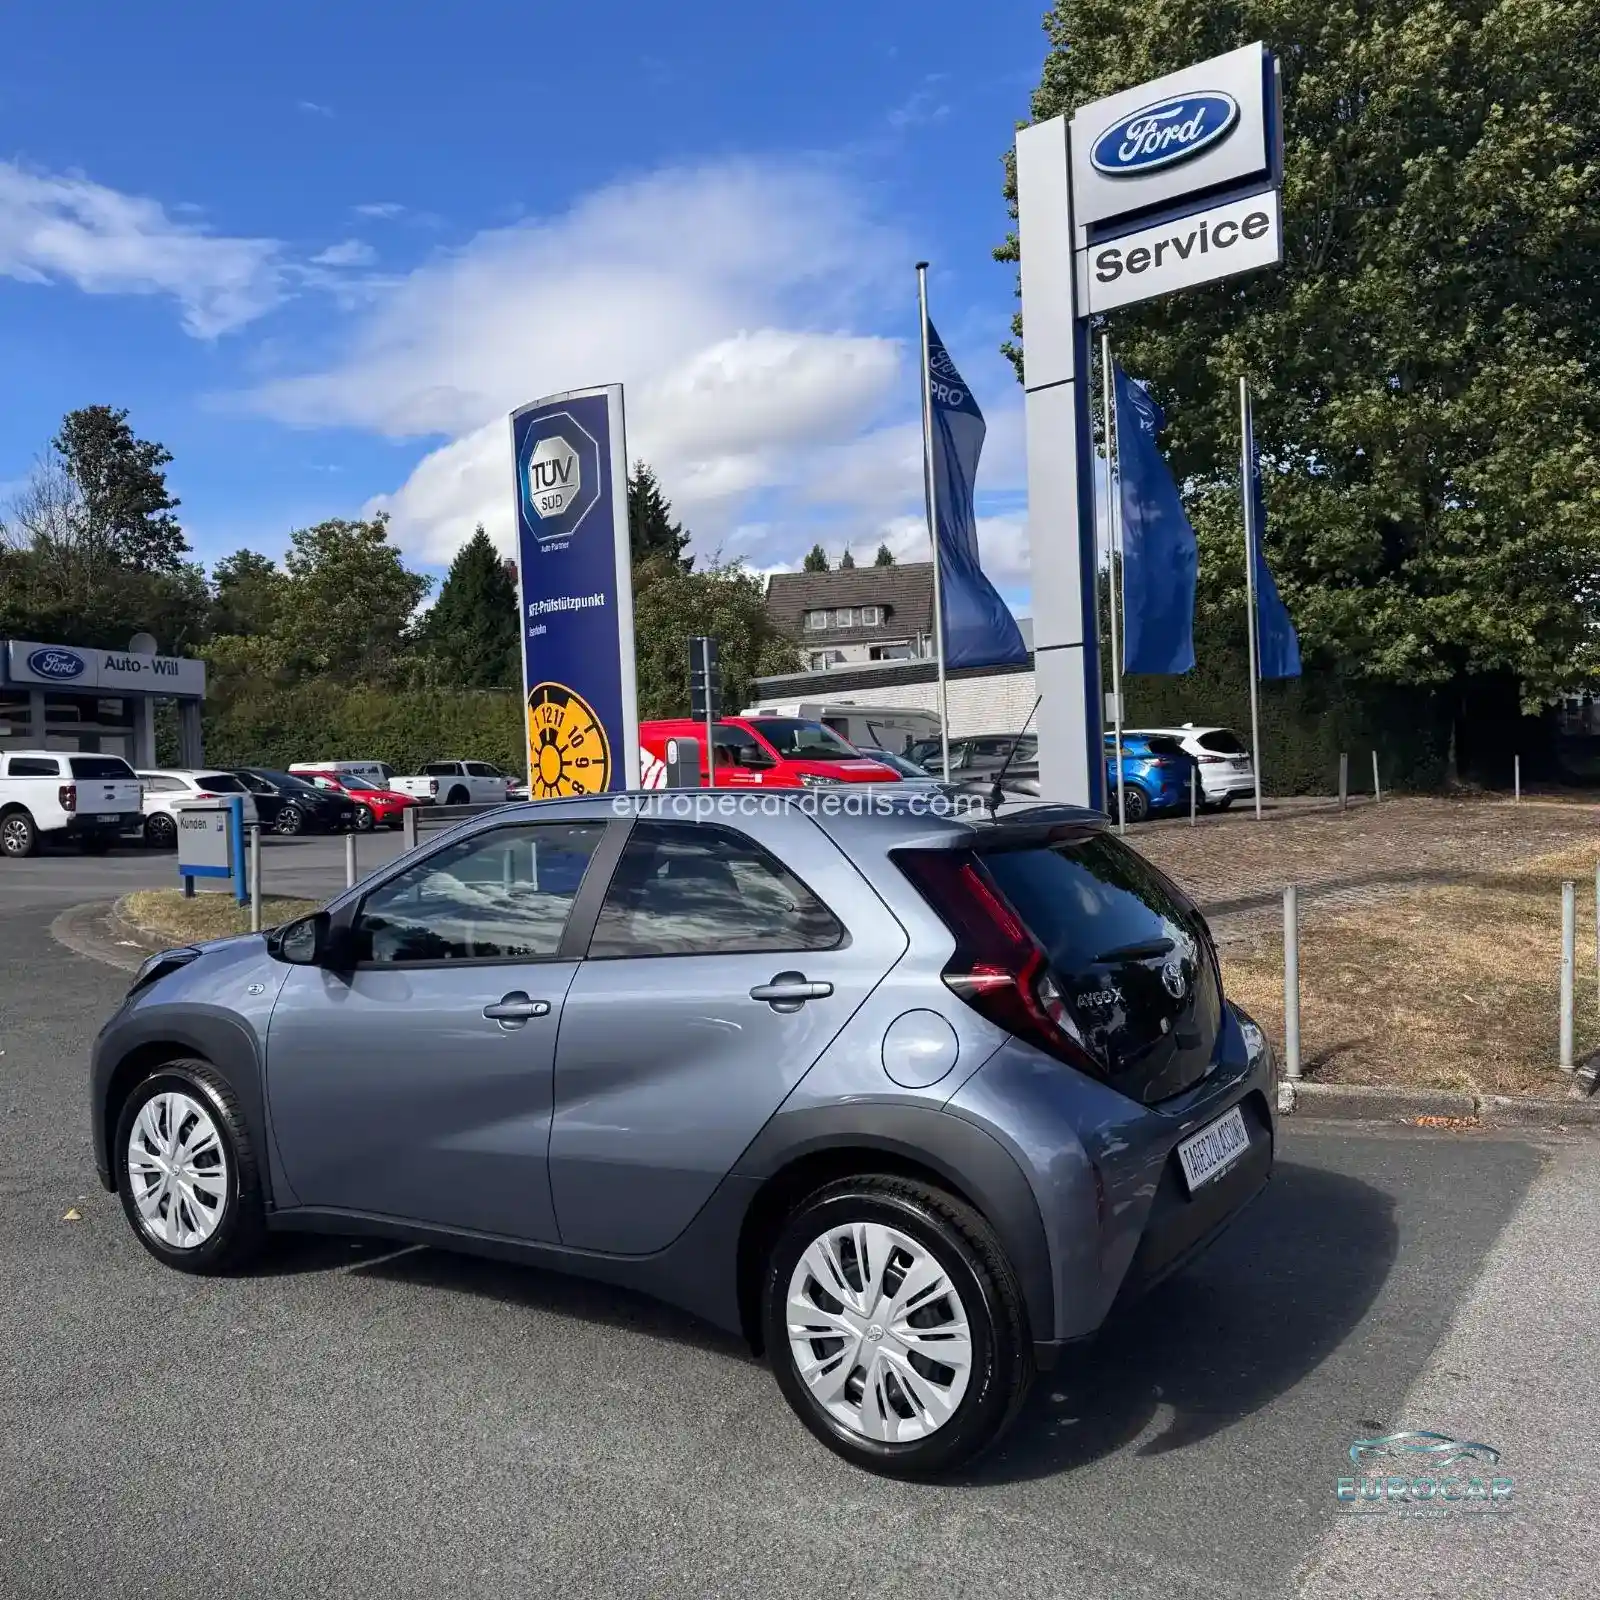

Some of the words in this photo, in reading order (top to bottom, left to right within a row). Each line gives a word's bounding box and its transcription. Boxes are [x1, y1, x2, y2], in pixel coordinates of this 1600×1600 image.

[1118, 106, 1206, 161] Ford
[1095, 211, 1270, 283] Service
[532, 456, 573, 489] TÜV
[529, 593, 605, 617] KFZ-Prüfstützpunkt
[42, 653, 76, 673] Ford
[541, 706, 553, 724] 12
[553, 708, 565, 728] 11
[567, 725, 585, 749] 10
[180, 817, 208, 830] Kunden
